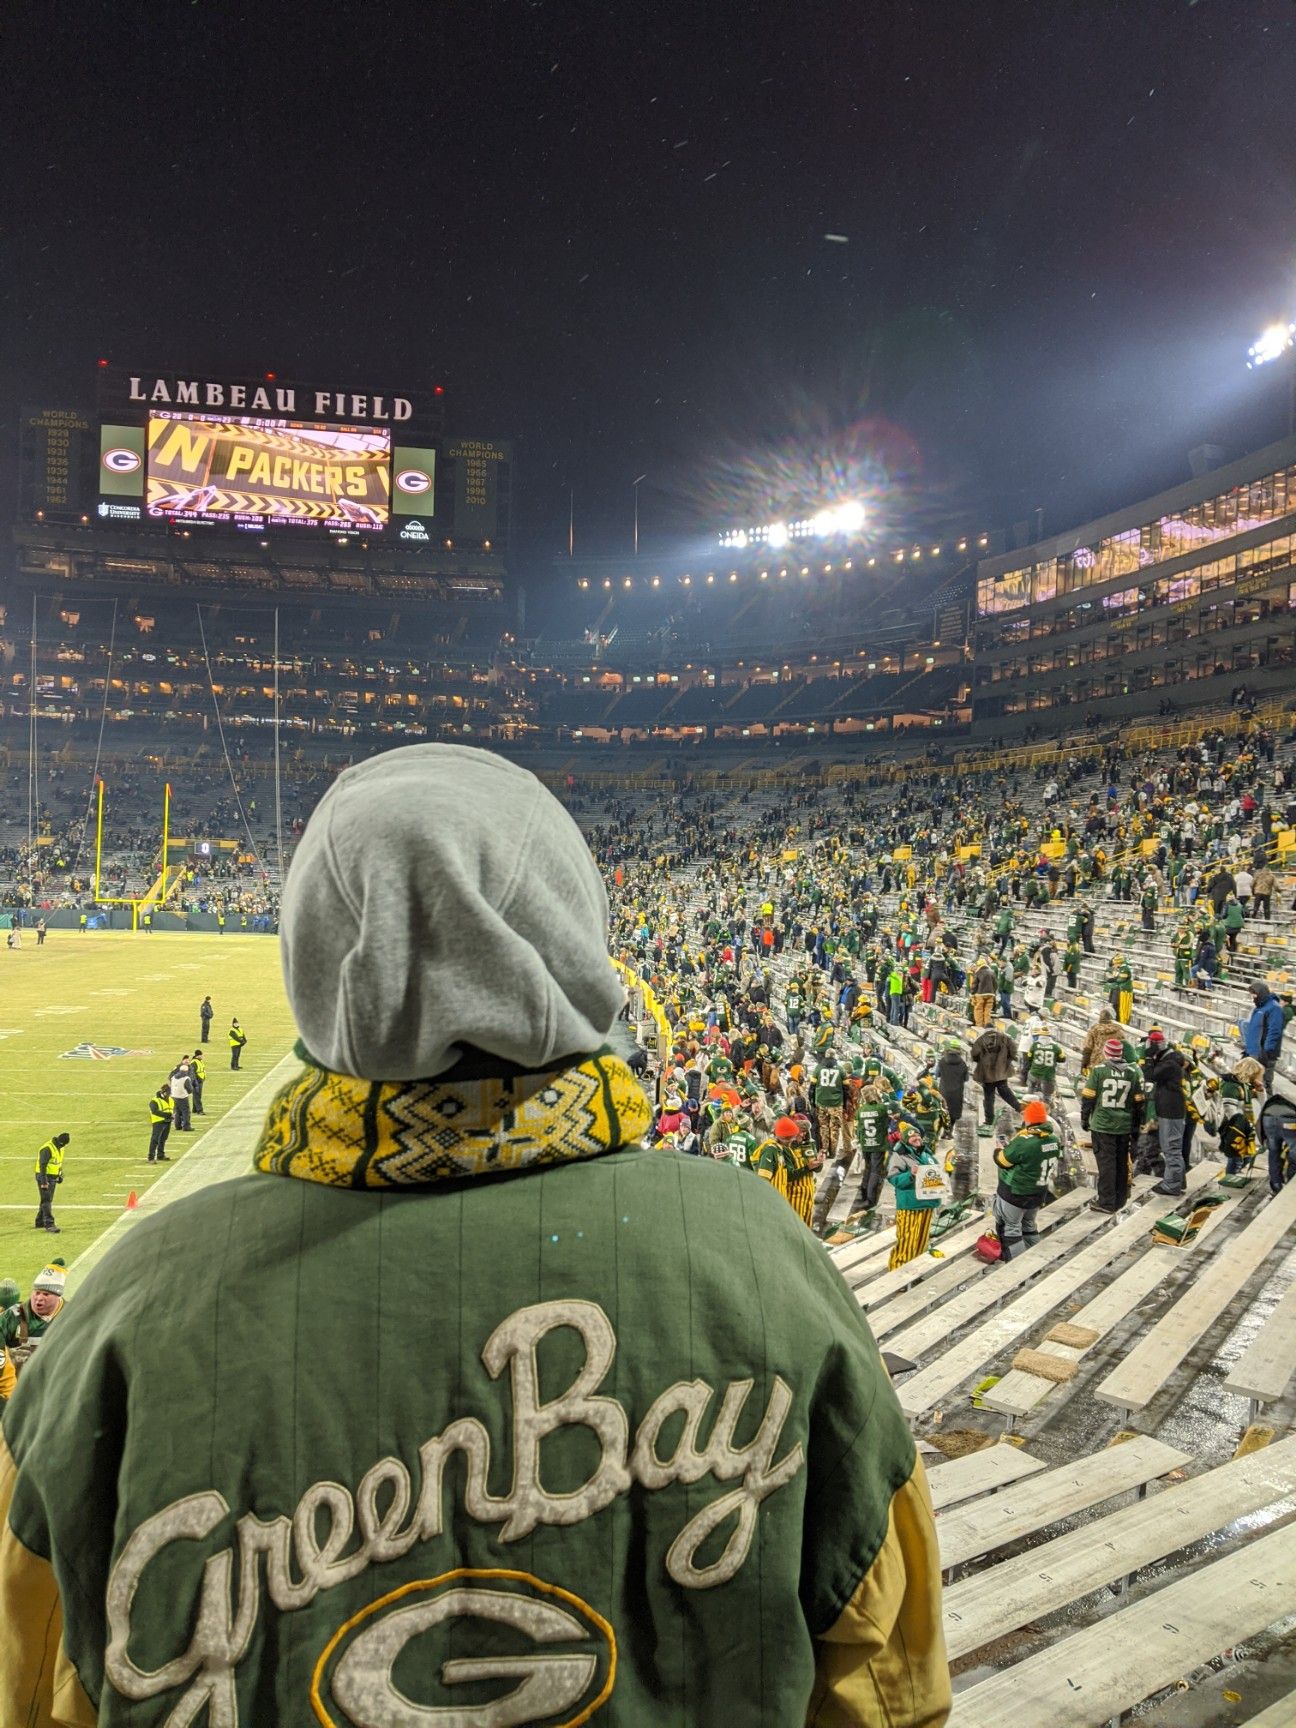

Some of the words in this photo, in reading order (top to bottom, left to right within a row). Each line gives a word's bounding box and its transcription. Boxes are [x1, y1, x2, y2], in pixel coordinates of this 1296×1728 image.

[129, 377, 297, 413] LAMBEAU
[314, 391, 413, 421] FIELD
[42, 410, 77, 419] WORLD
[29, 417, 89, 429] CHAMPIONS
[460, 441, 493, 450] WORLD
[448, 449, 504, 460] CHAMPIONS
[225, 446, 368, 496] PACKERS
[465, 496, 486, 505] 2010
[400, 530, 430, 540] ONEIDA
[788, 998, 799, 1009] 12
[1034, 1049, 1055, 1067] 38
[819, 1068, 840, 1087] 87
[1102, 1078, 1131, 1108] 27
[863, 1118, 877, 1138] 5
[729, 1143, 747, 1163] 58
[104, 1416, 514, 1728] Green
[481, 1298, 805, 1591] Bay
[1038, 1573, 1053, 1584] 5
[1249, 1578, 1267, 1589] 5
[330, 1587, 599, 1728] G
